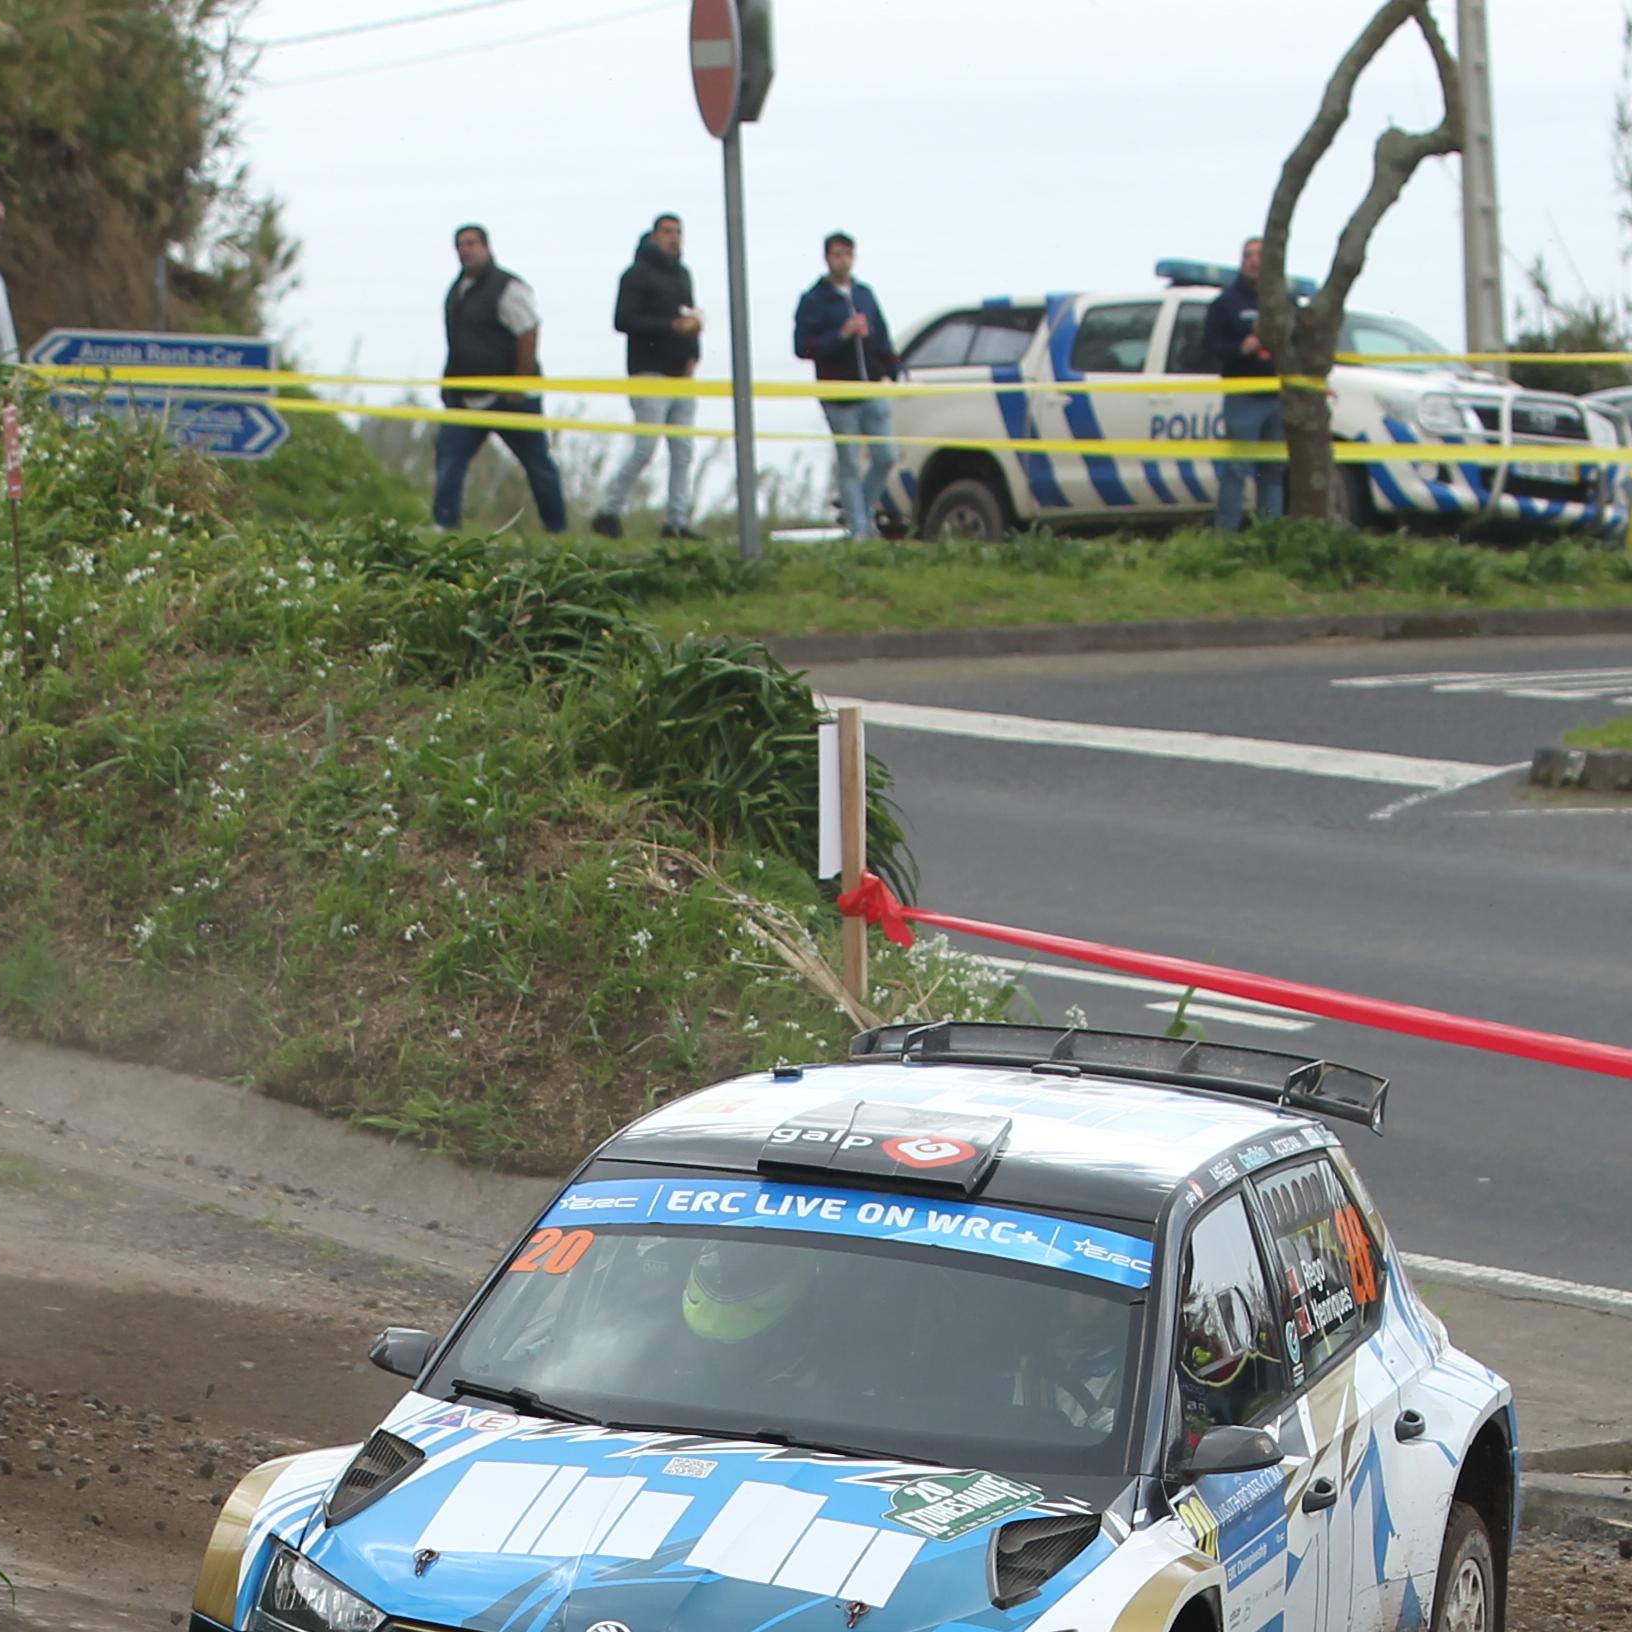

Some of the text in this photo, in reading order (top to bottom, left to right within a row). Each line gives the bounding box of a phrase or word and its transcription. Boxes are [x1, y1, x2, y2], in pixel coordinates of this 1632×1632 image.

[77, 341, 144, 359] Arruda
[1150, 403, 1227, 440] POLÍC
[770, 1127, 873, 1150] galp
[569, 1195, 639, 1210] ERC
[666, 1190, 1040, 1244] ERC LIVE ON WRC+
[508, 1227, 596, 1274] 20
[1300, 1258, 1326, 1292] Rego
[1310, 1286, 1353, 1330] Henriques
[903, 1480, 955, 1503] 20
